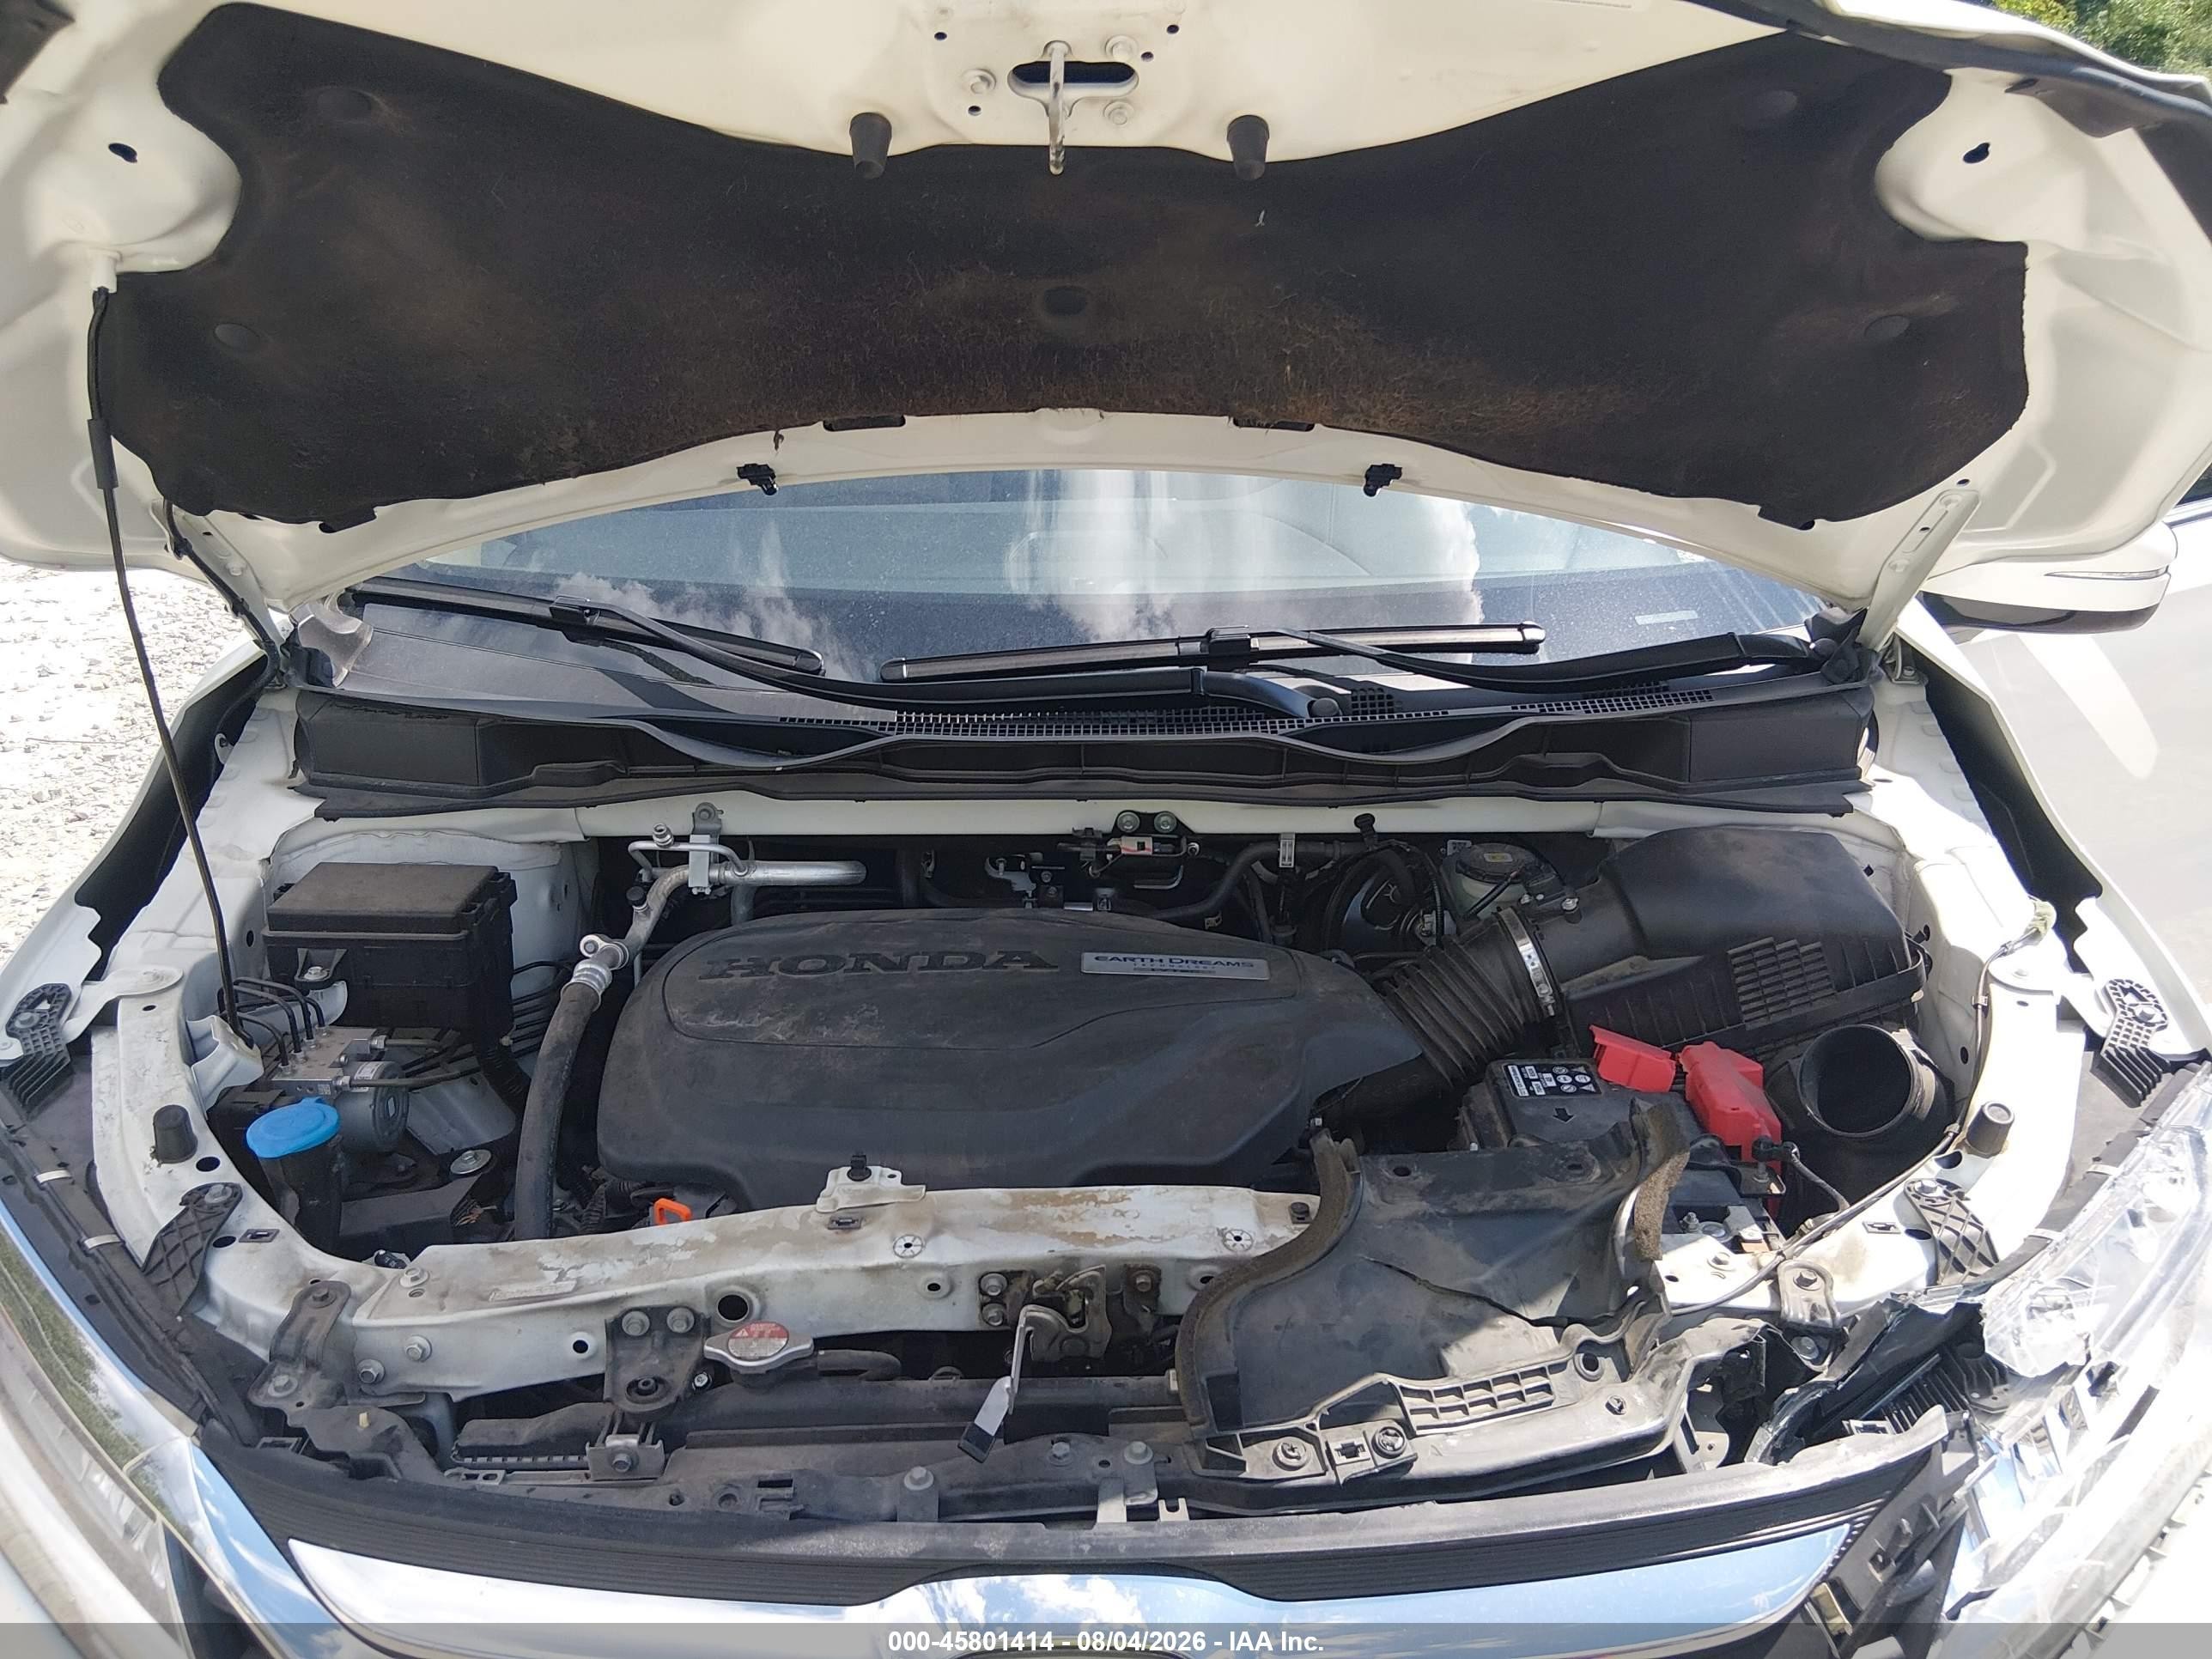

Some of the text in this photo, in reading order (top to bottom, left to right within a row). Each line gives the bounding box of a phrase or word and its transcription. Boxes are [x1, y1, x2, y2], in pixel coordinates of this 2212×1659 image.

[698, 951, 1060, 980] HONDA
[1094, 955, 1255, 968] EARTH DREAMS
